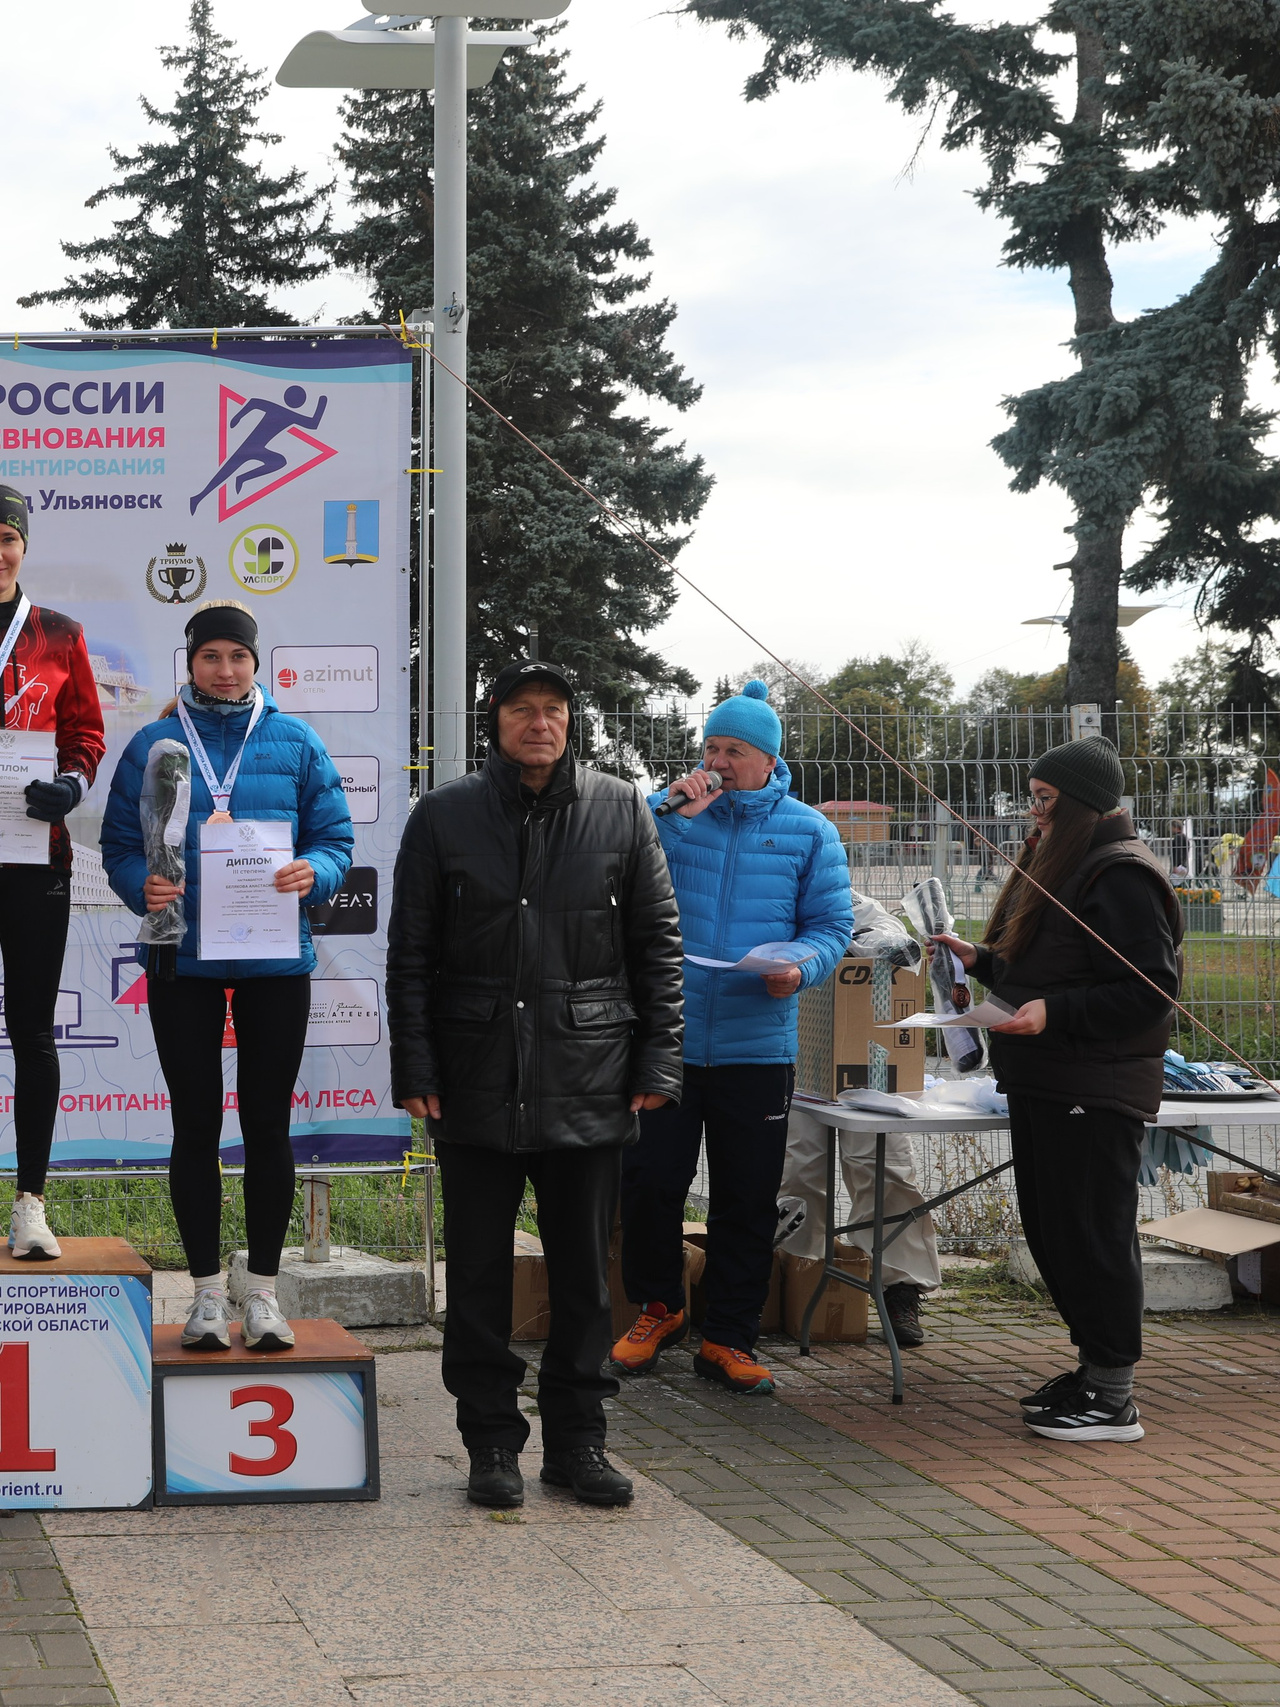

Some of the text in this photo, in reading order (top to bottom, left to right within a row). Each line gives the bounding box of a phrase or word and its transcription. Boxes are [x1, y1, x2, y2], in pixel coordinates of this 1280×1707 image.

[39, 489, 163, 510] Ульяновск
[243, 575, 284, 583] УЛСПОРТ
[303, 664, 374, 682] azimut
[226, 857, 272, 867] ДИПЛОМ
[839, 965, 902, 985] CDK
[315, 1088, 377, 1108] ЛЕСА
[6, 1285, 121, 1300] СПОРТИВНОГО
[37, 1318, 110, 1333] ОБЛАСТИ
[228, 1383, 298, 1477] 3
